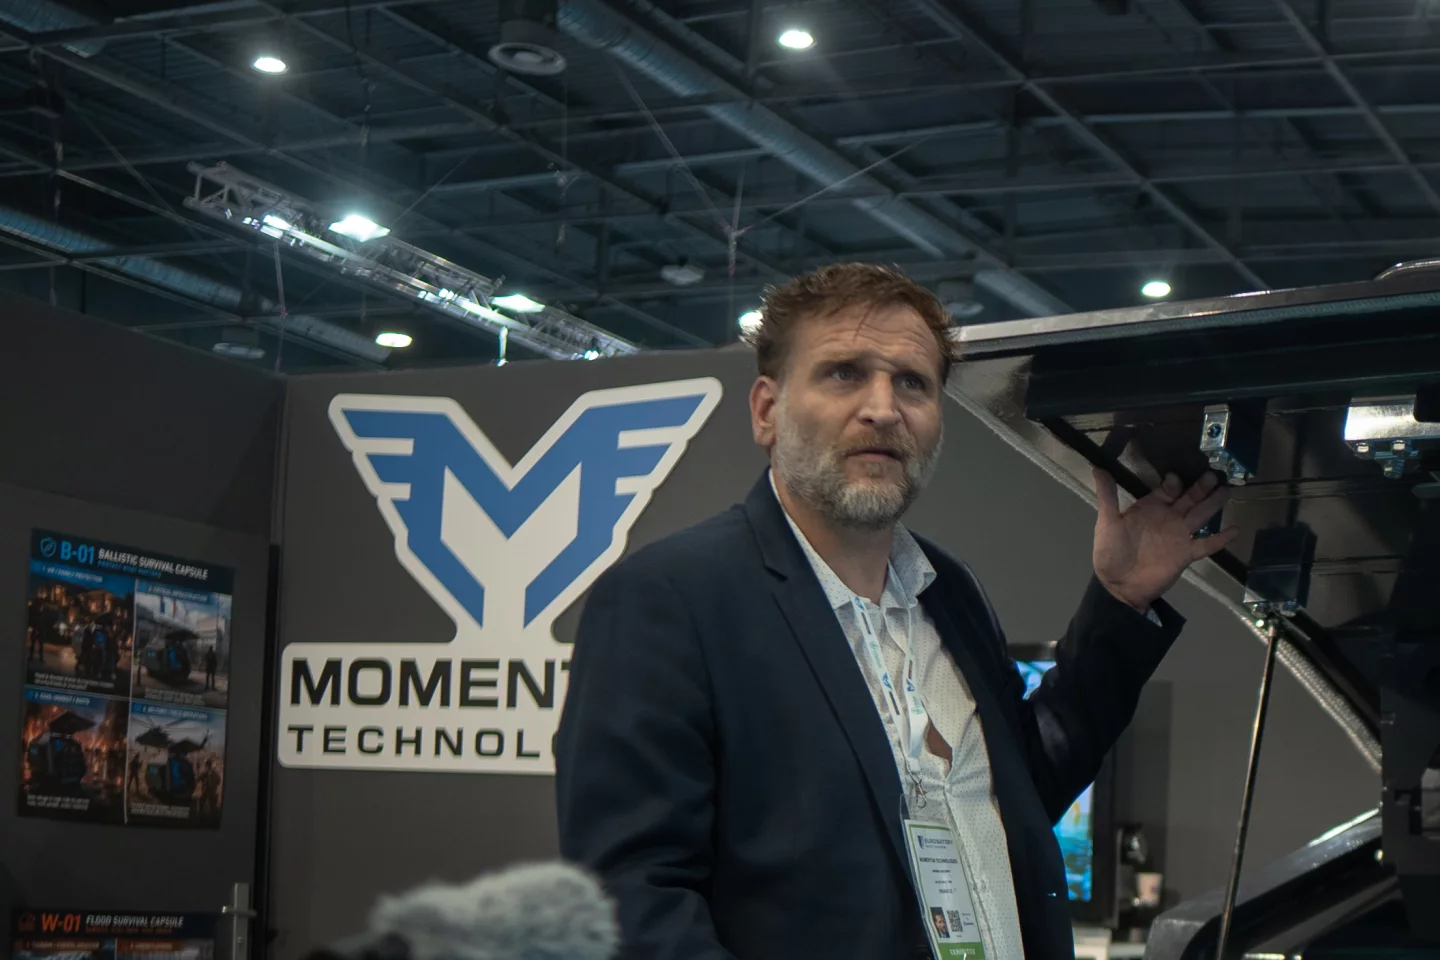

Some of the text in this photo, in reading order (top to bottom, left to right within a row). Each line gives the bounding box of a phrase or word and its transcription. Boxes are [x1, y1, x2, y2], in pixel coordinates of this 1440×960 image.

[60, 540, 95, 565] B-01
[98, 547, 138, 566] BALLISTIC
[138, 555, 175, 574] SURVIVAL
[175, 563, 209, 581] CAPSULE
[287, 724, 557, 759] TECHNOL
[41, 912, 81, 933] W-01
[86, 914, 112, 927] FLOOD
[113, 915, 149, 927] SURVIVAL
